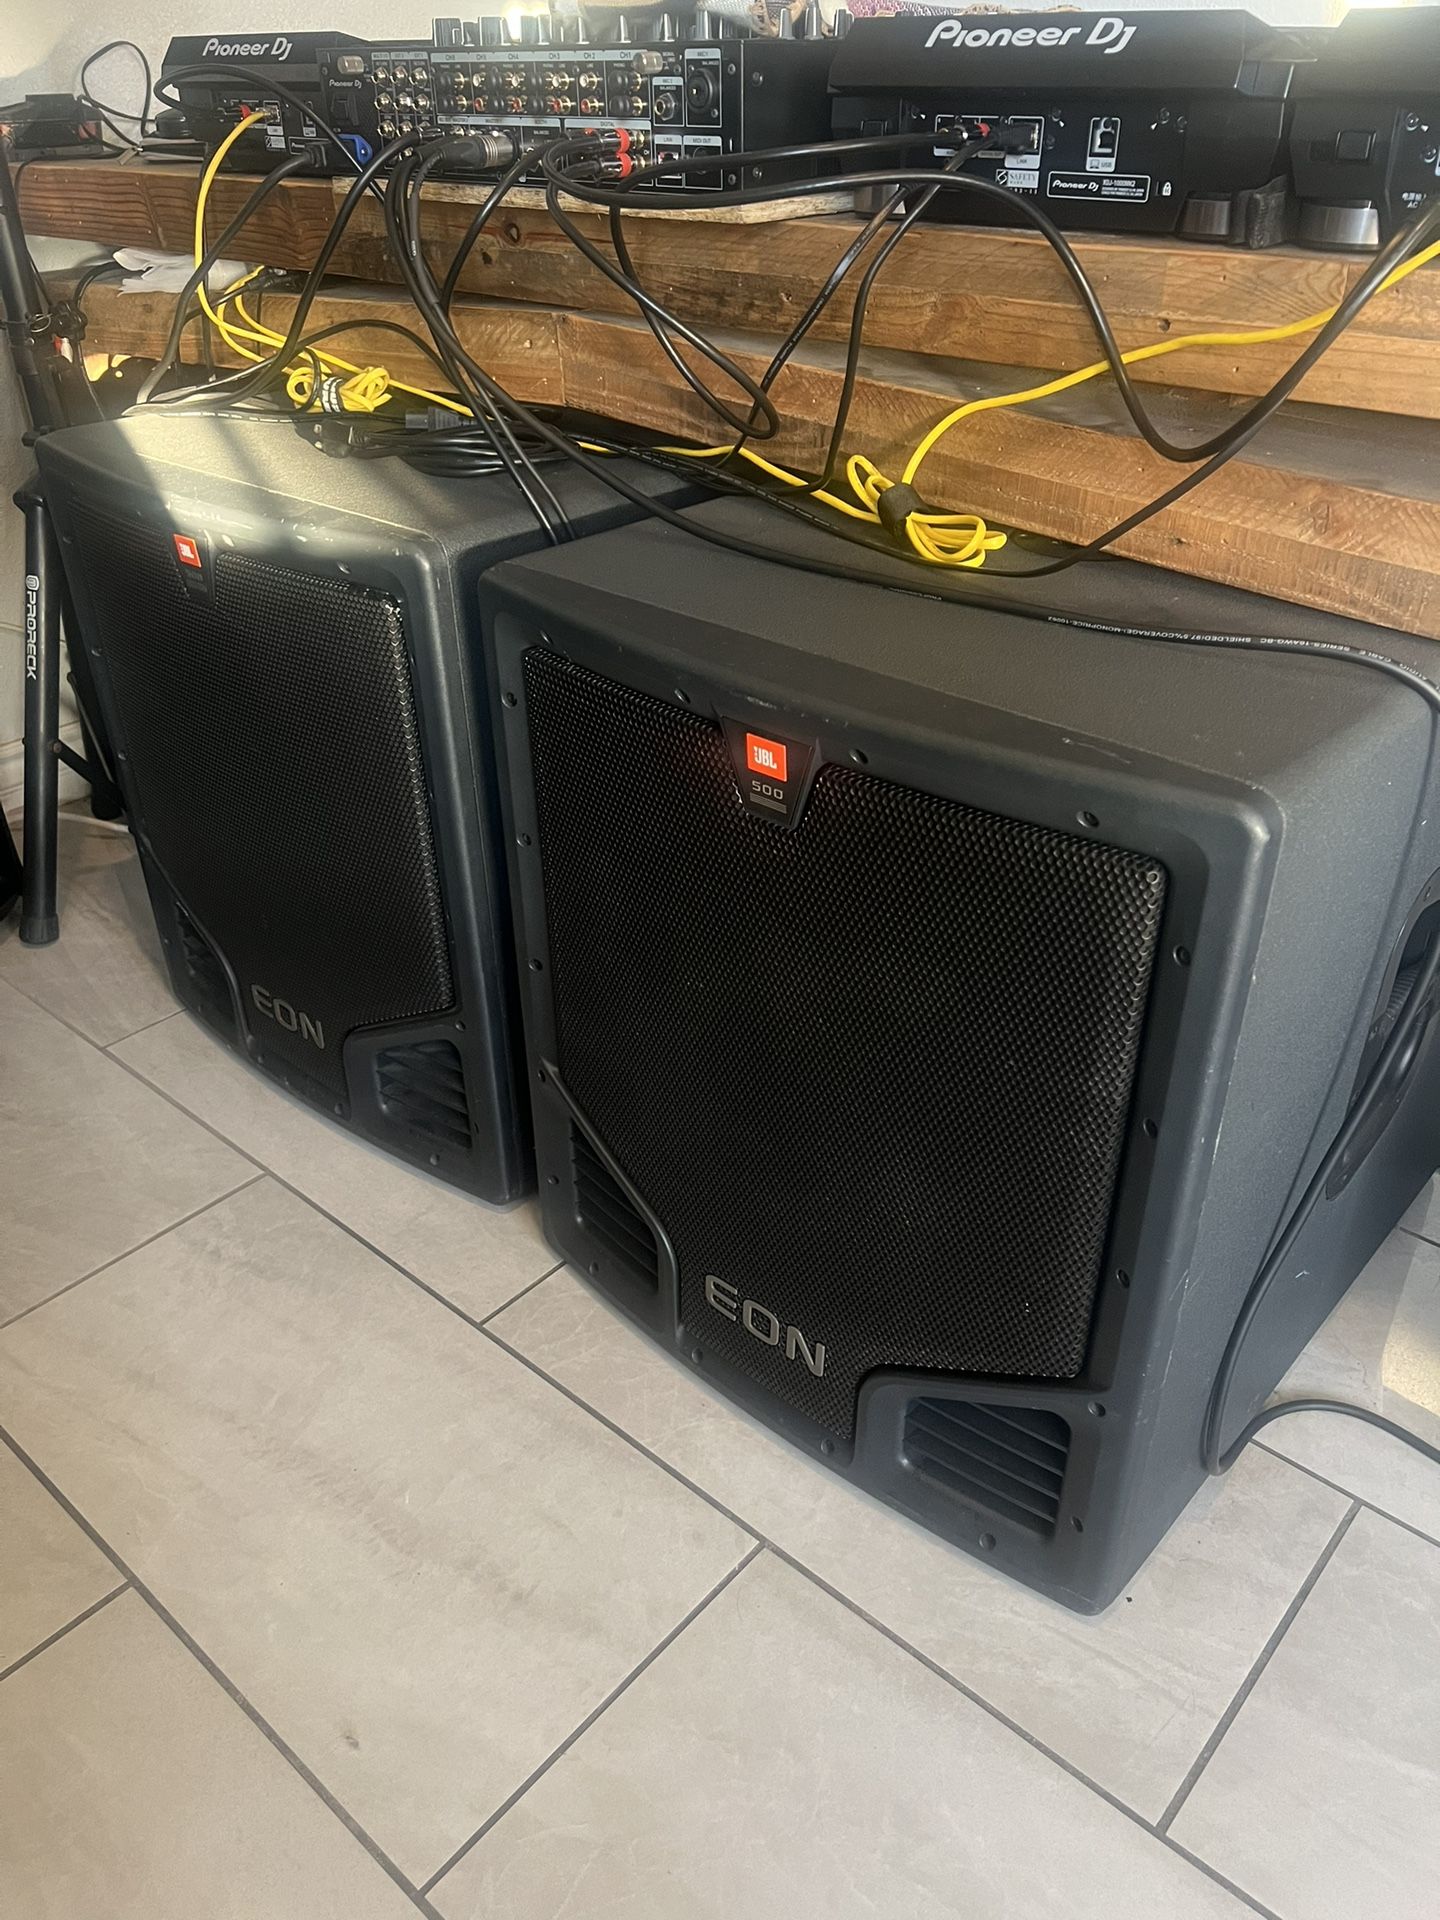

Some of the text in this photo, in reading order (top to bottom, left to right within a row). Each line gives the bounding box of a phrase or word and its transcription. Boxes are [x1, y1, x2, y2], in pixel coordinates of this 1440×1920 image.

[925, 19, 1081, 48] Pioneer
[202, 38, 269, 56] Pioneer
[329, 79, 353, 87] Pioneer
[1052, 180, 1087, 190] Pioneer
[26, 590, 37, 681] PRORECK
[753, 745, 778, 770] JBL
[751, 780, 783, 800] 500
[251, 983, 325, 1050] EON
[705, 1274, 826, 1377] EON
